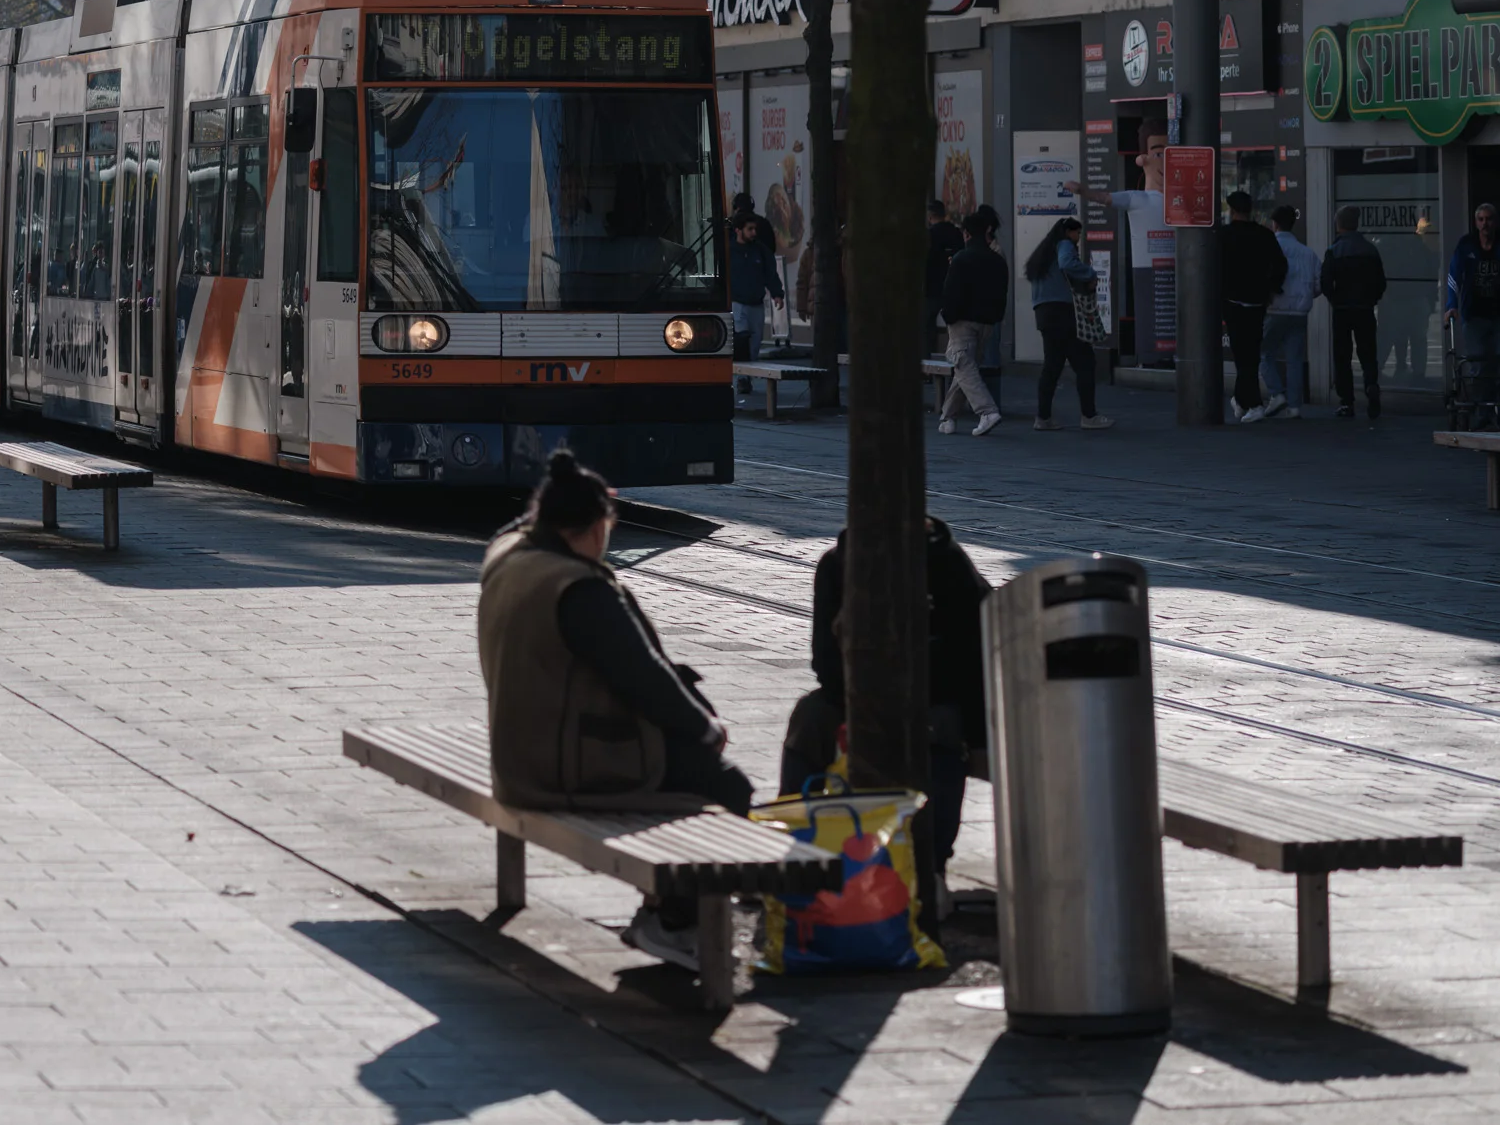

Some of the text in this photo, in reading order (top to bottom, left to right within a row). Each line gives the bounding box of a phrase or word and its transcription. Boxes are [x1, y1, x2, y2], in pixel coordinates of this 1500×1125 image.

[1282, 22, 1300, 34] iPhone
[1157, 66, 1168, 82] Ihr
[1218, 63, 1240, 82] perte
[1313, 37, 1333, 108] 2
[762, 107, 787, 128] BURGER
[937, 96, 954, 119] HOT
[1360, 205, 1418, 228] IELPARK
[342, 287, 357, 303] 5649
[391, 363, 433, 379] 5649
[529, 361, 591, 382] rnv
[335, 383, 347, 394] rnv
